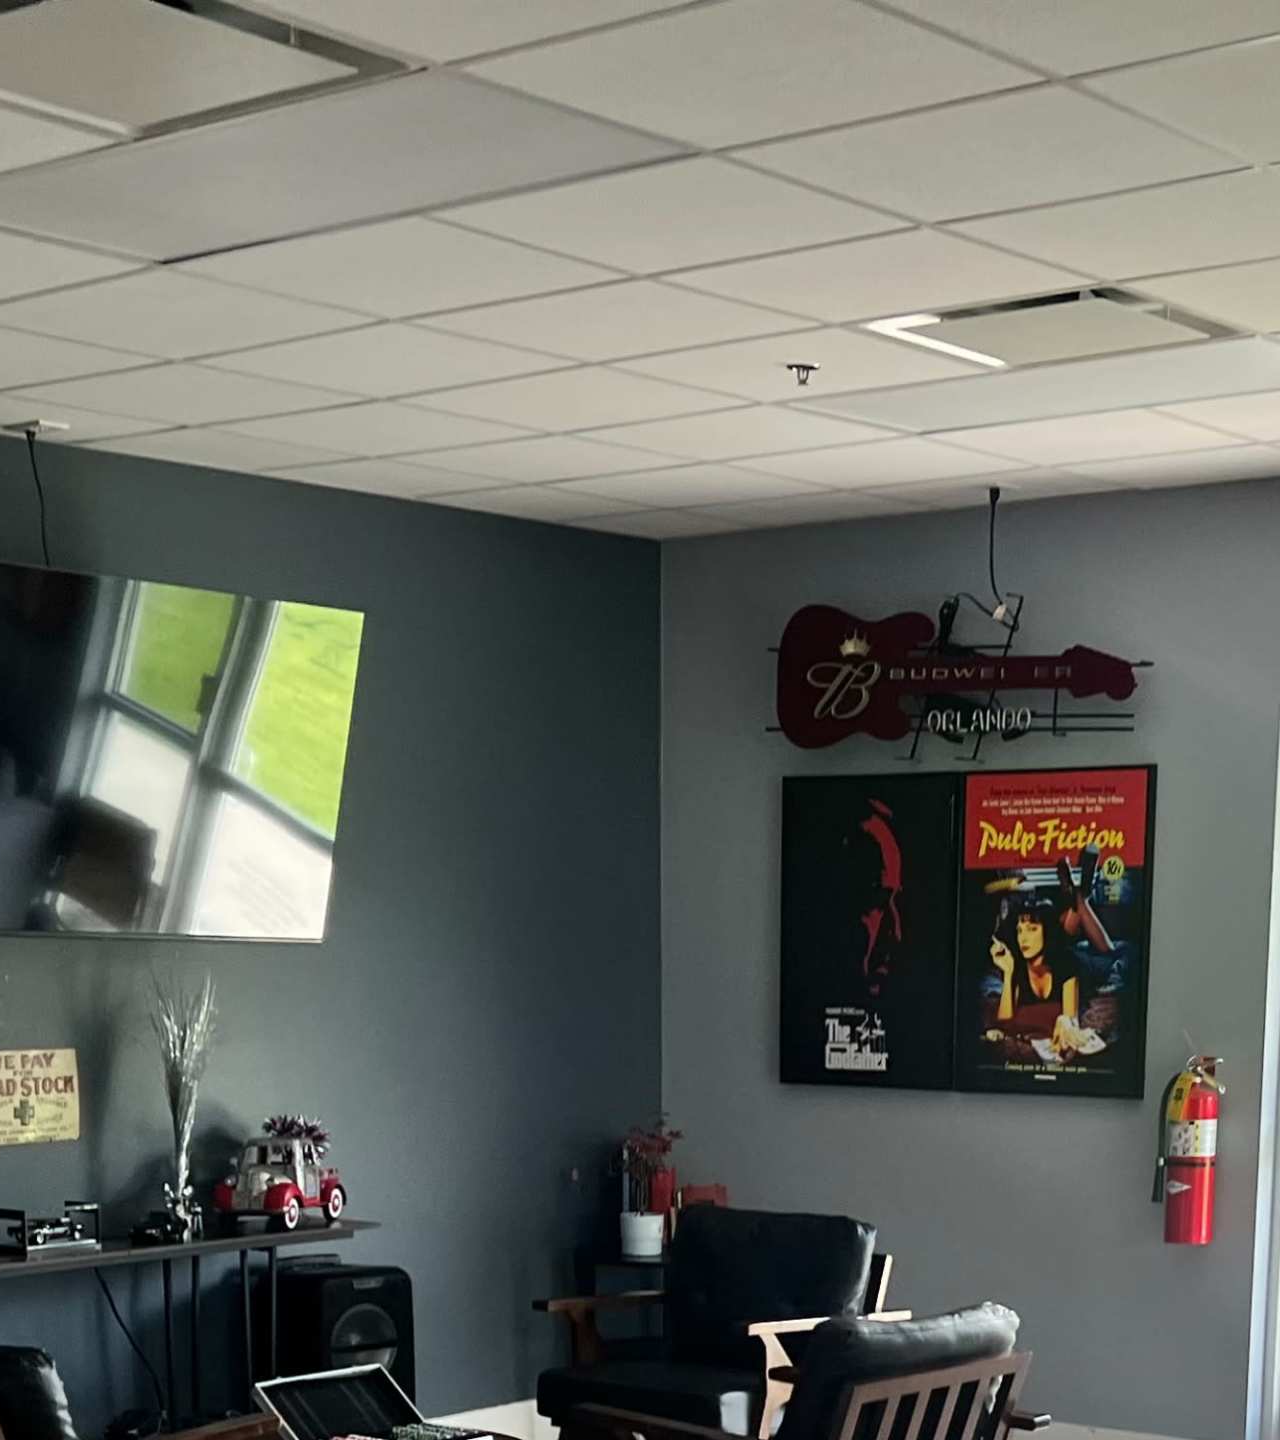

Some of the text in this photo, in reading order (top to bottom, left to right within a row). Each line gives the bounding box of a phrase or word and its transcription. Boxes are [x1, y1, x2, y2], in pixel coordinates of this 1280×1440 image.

[889, 666, 1072, 681] BUDWEIER
[927, 707, 1032, 733] ORLANDO
[978, 817, 1126, 858] Pulp Fiction
[825, 1018, 851, 1043] The
[20, 1053, 55, 1069] PAY
[21, 1076, 74, 1097] STOCK
